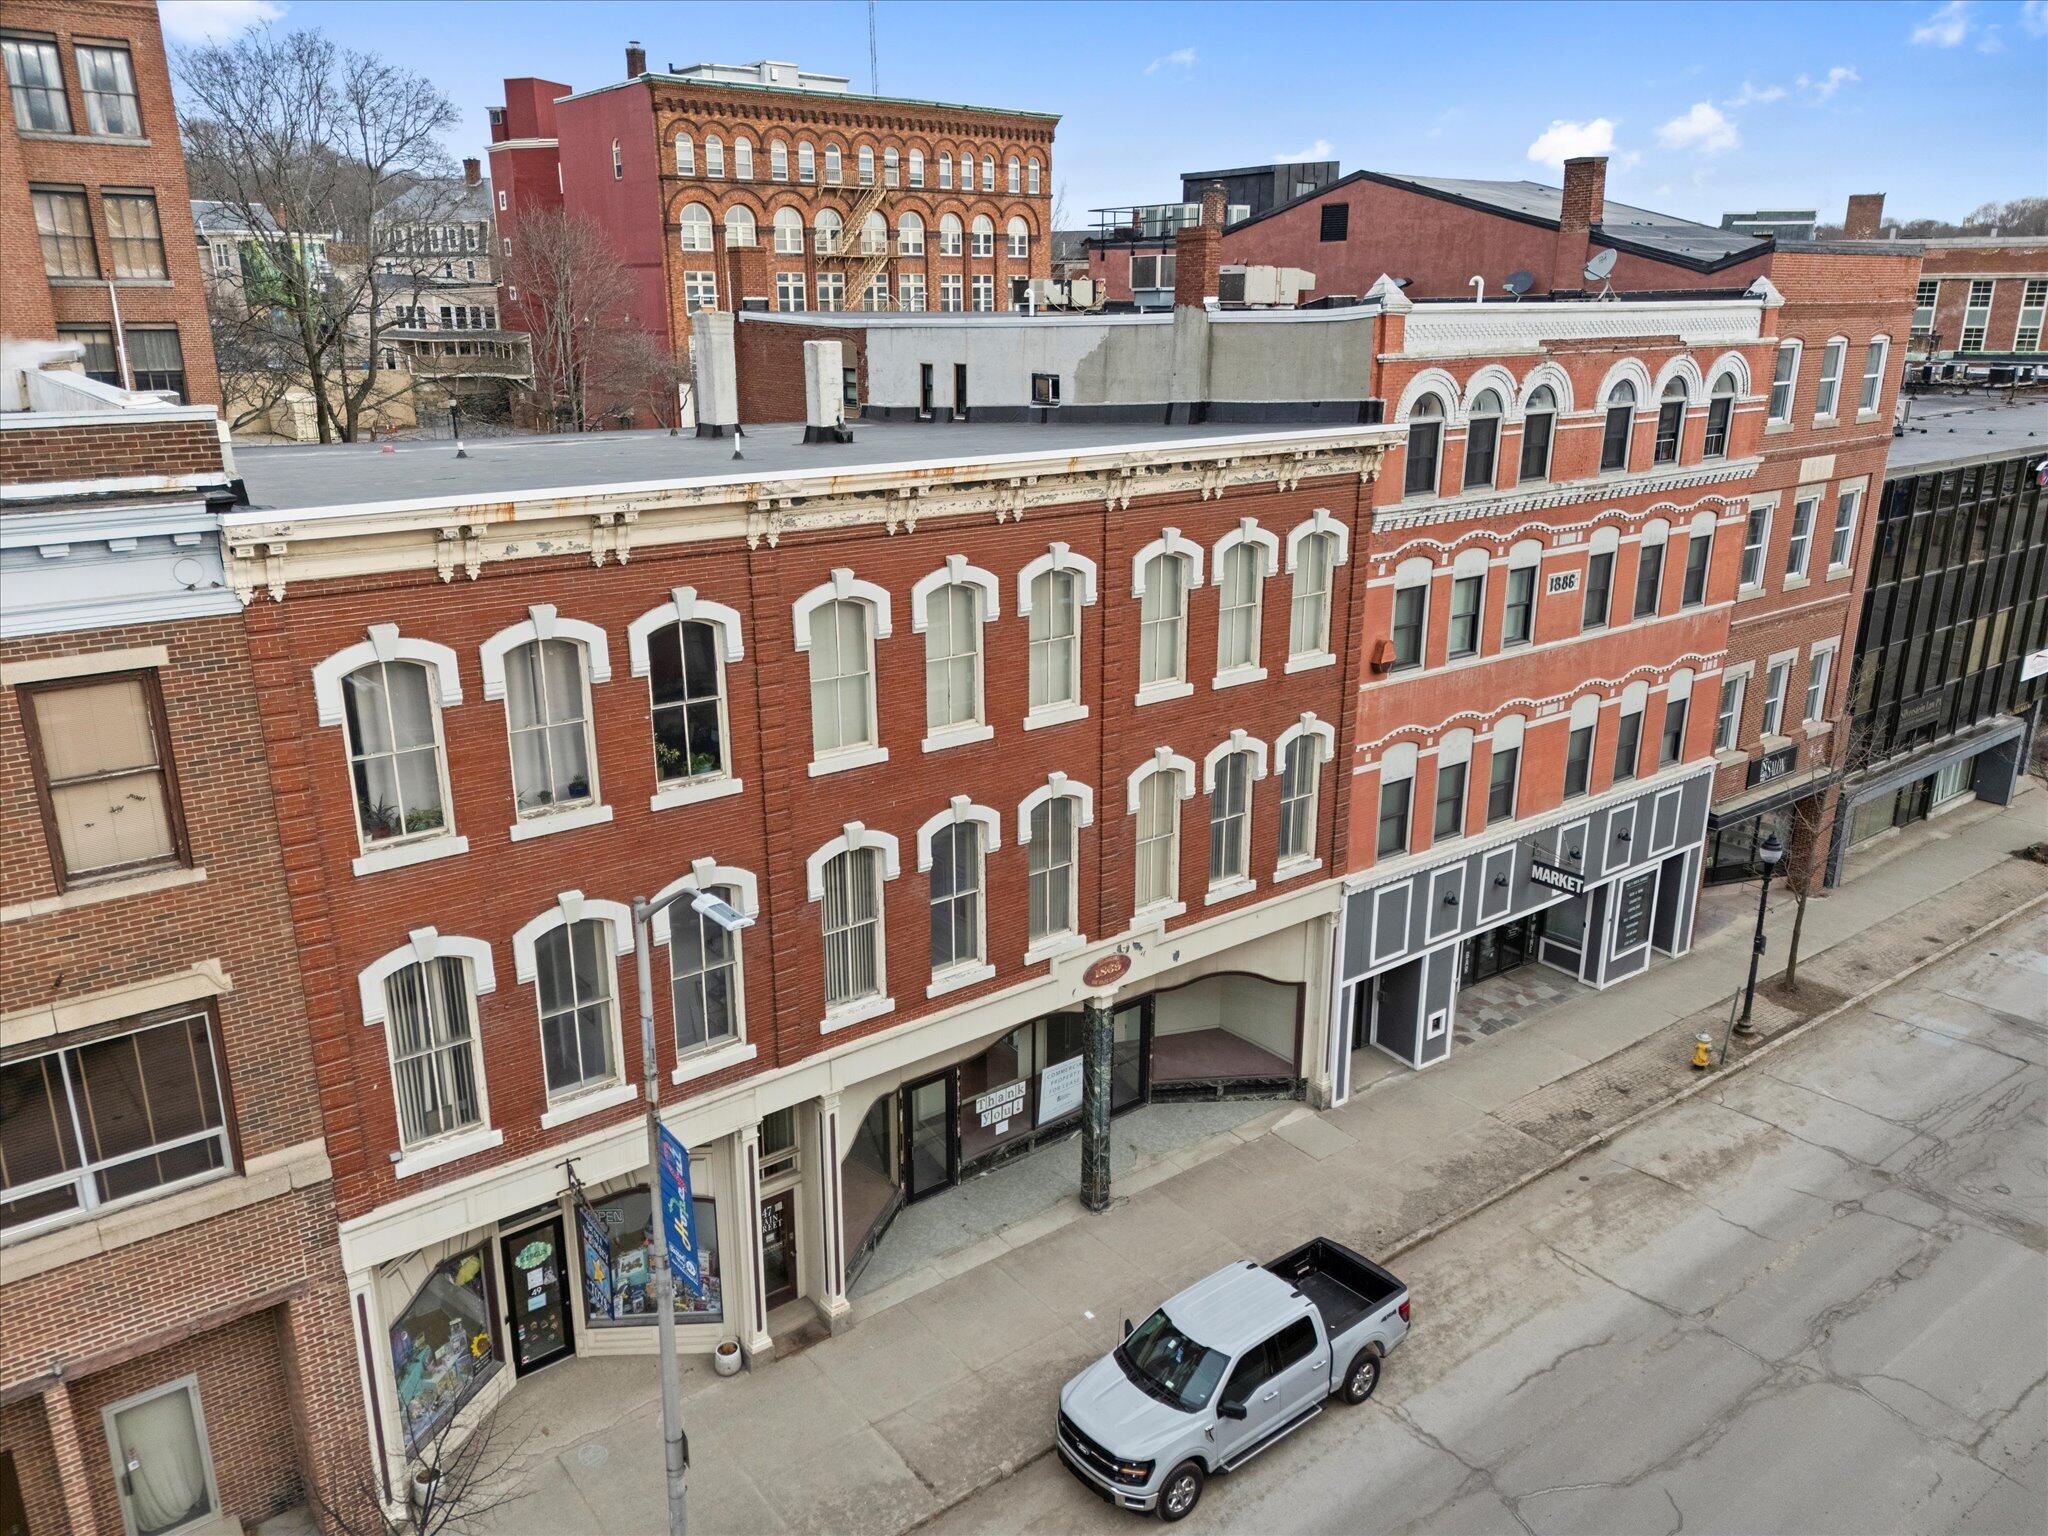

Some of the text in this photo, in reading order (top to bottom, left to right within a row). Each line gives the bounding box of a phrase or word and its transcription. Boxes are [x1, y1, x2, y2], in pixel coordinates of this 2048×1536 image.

[1549, 573, 1576, 592] 1886
[1531, 864, 1584, 894] MARKET
[1046, 1062, 1083, 1080] COMMERCIA
[1050, 1070, 1081, 1086] PROPERTY
[1049, 1078, 1081, 1094] FOR LEASE
[977, 1083, 1025, 1111] Thank
[762, 1205, 773, 1218] 47
[762, 1218, 783, 1234] REET
[531, 1286, 542, 1297] 49
